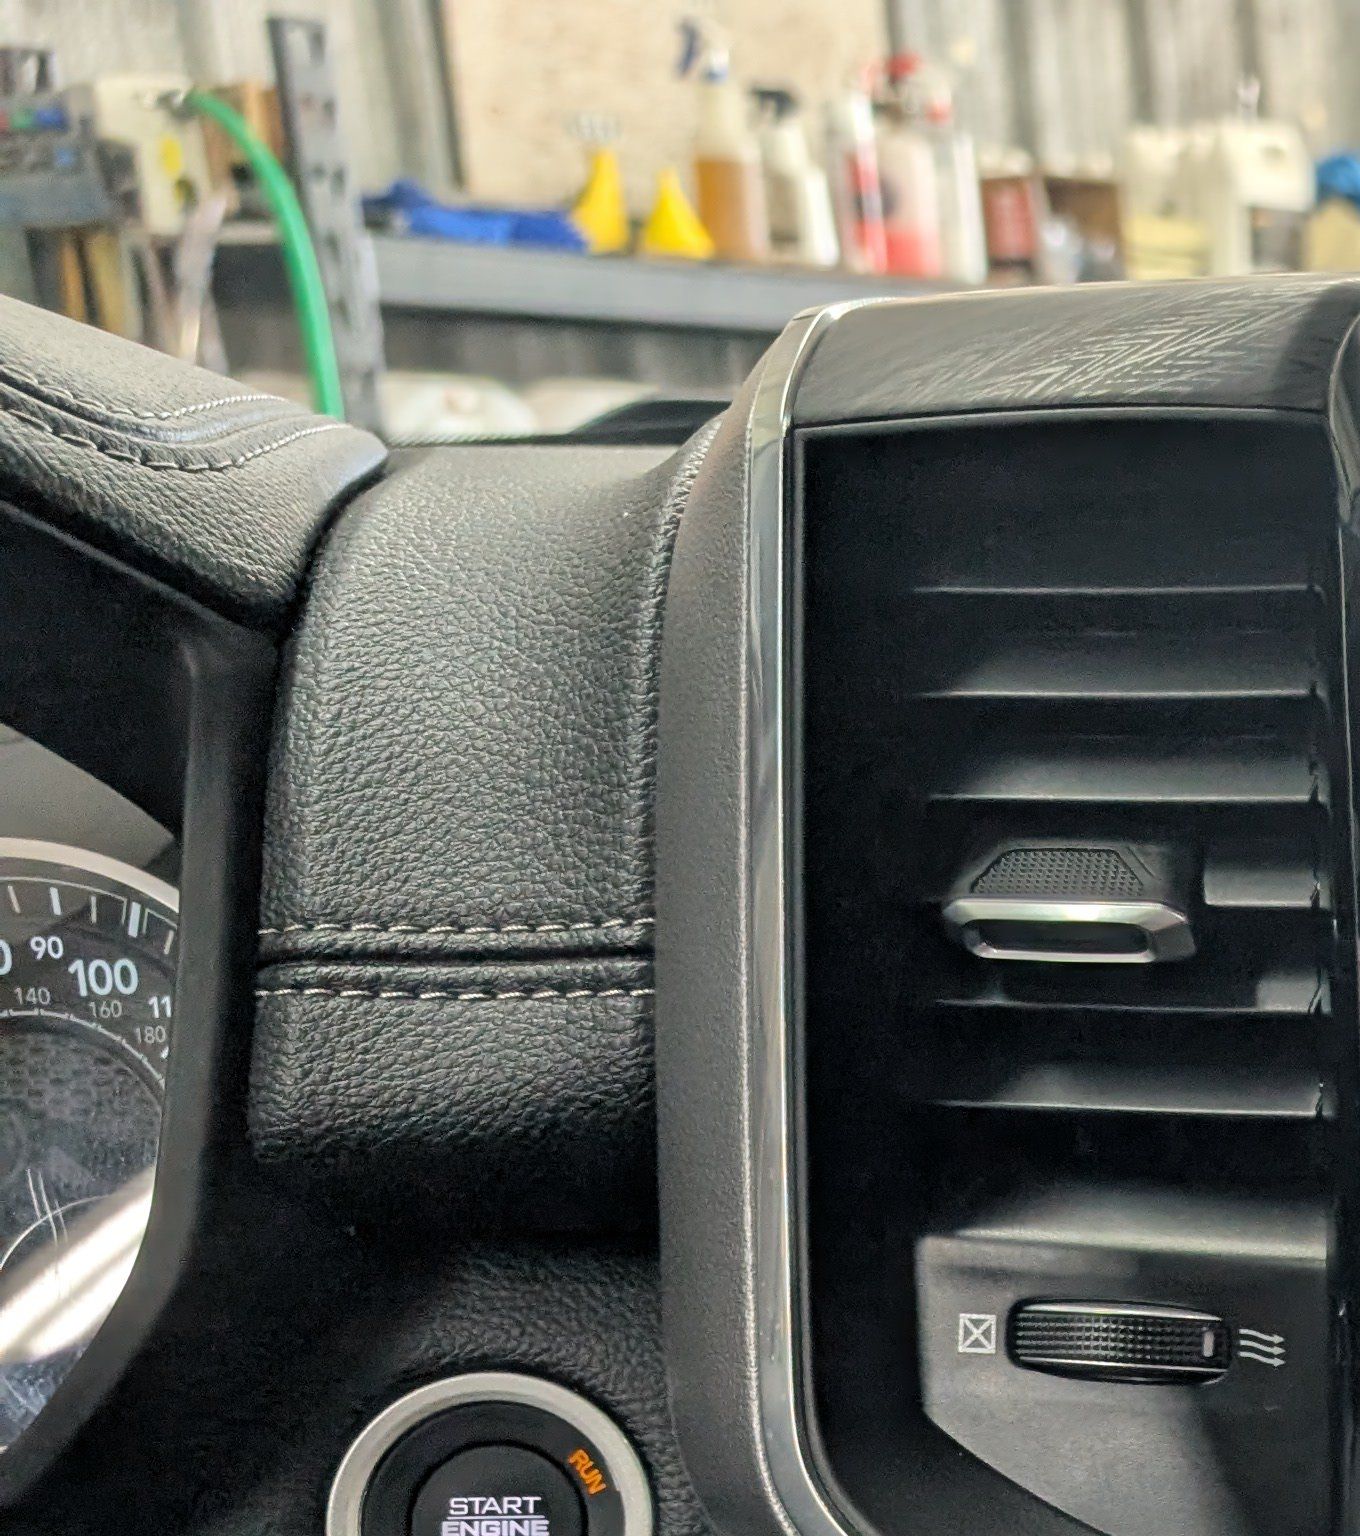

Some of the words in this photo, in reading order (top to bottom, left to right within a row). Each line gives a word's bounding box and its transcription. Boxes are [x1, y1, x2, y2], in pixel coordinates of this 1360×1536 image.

[30, 935, 64, 960] 90
[68, 957, 138, 997] 100
[89, 1001, 122, 1019] 160
[135, 1025, 166, 1044] 180
[567, 1449, 607, 1497] RUN
[449, 1496, 542, 1515] START
